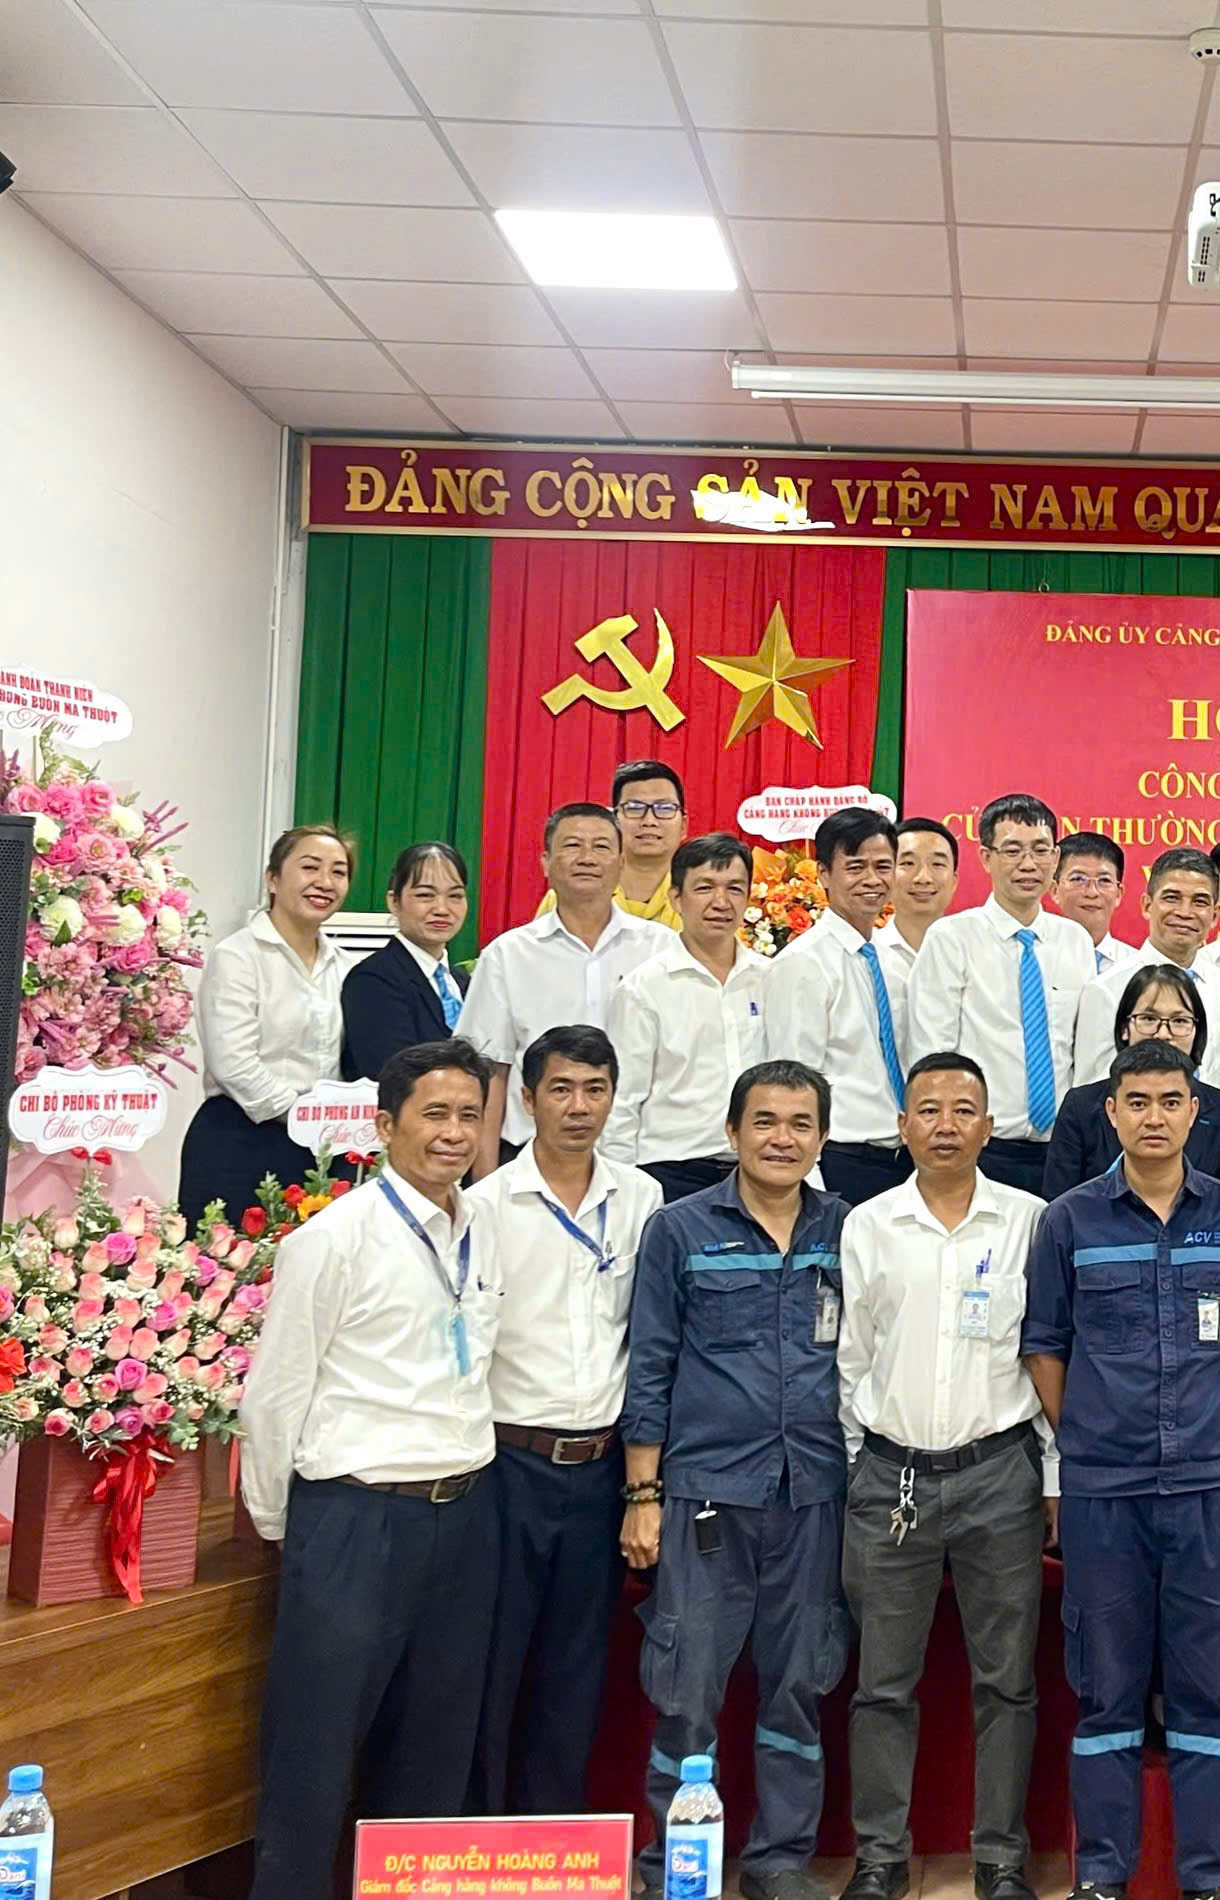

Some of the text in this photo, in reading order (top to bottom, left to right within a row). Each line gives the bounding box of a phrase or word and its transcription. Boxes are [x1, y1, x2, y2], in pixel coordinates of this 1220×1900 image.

[344, 449, 510, 516] ĐẢNG
[525, 457, 676, 529] CỘNG
[832, 468, 970, 537] VIỆT
[990, 484, 1118, 530] NAM
[1045, 620, 1112, 644] ĐẢNG
[1118, 621, 1150, 644] ỦY
[1155, 623, 1220, 646] CẢNG
[0, 667, 17, 688] ÀNH
[64, 702, 79, 716] MA
[20, 1095, 39, 1112] CHI
[43, 1090, 58, 1112] BỘ
[62, 1090, 100, 1111] PHÒNG
[122, 1089, 157, 1113] THUẬT
[1184, 1231, 1212, 1244] ACV
[424, 1845, 490, 1871] NGUYỄN
[496, 1849, 556, 1871] HOÀNG
[563, 1852, 599, 1870] ANH
